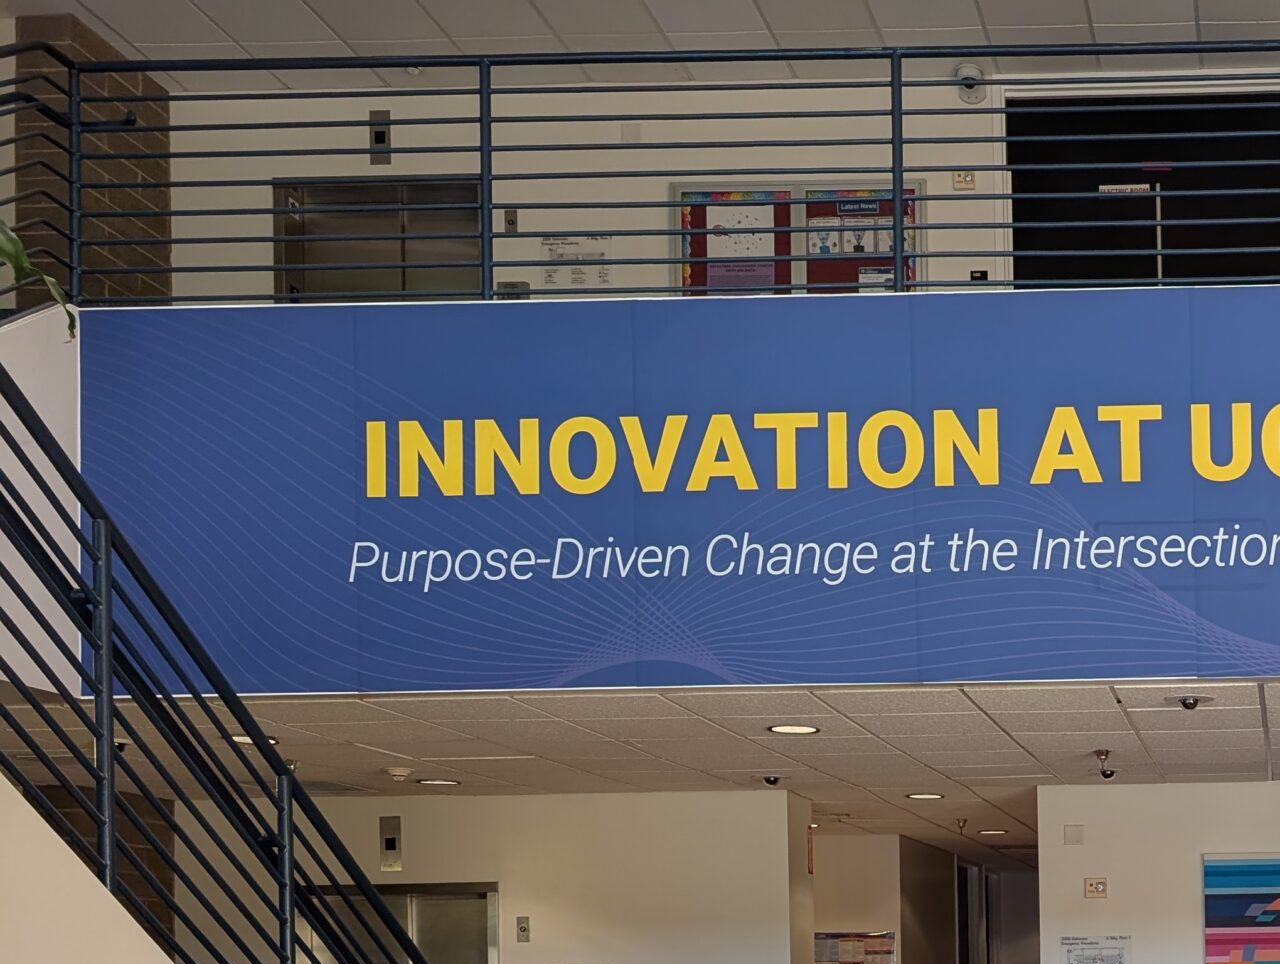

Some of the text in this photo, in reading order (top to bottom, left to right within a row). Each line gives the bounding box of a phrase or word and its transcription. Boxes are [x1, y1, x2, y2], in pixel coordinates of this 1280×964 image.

[365, 408, 1000, 498] INNOVATION
[1030, 404, 1163, 486] AT
[348, 536, 690, 593] Purpose-Driven
[706, 532, 878, 586] Change
[890, 533, 936, 574] at
[947, 527, 1018, 572] the
